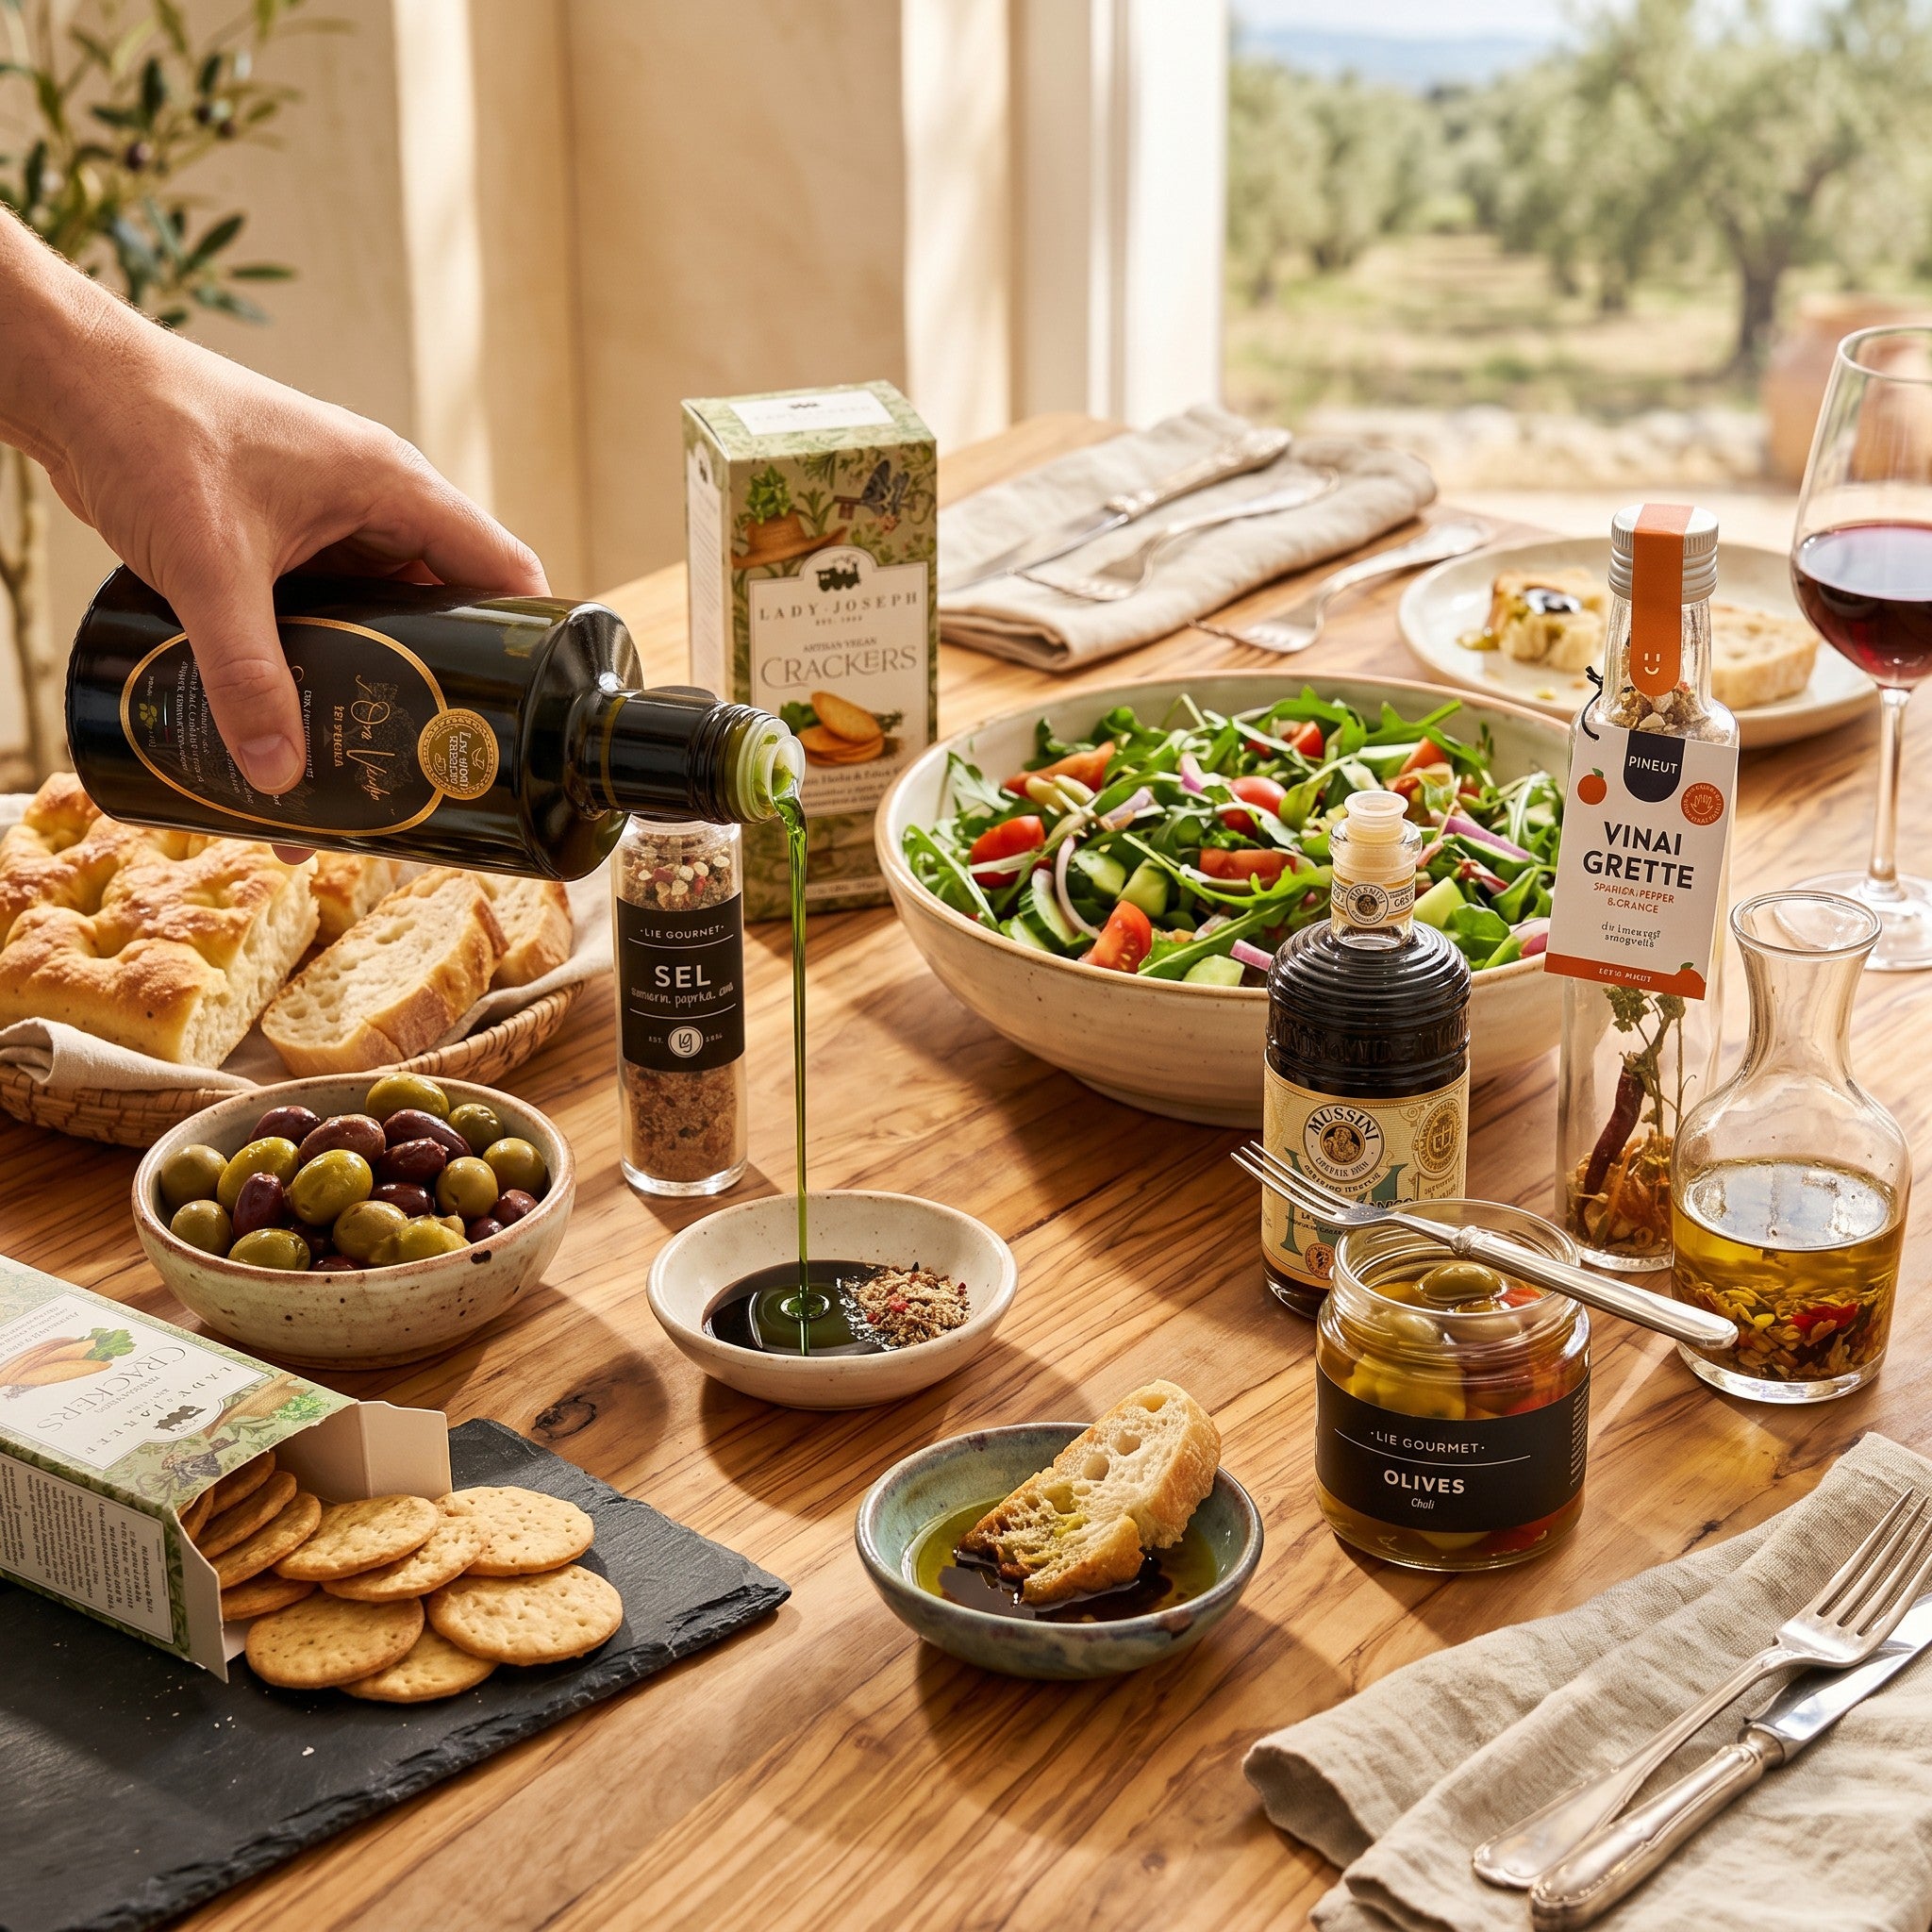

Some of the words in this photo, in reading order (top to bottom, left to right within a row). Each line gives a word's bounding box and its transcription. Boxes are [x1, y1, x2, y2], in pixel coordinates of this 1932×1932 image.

[759, 602, 820, 622] LADY
[832, 591, 918, 615] JOSEPH
[759, 644, 918, 690] CRACKERS
[1628, 756, 1678, 774] PINEUT
[1604, 821, 1682, 856] VINAI
[1583, 850, 1694, 890] GRETTE
[1639, 890, 1674, 904] PEPPER
[644, 927, 662, 939] LIE
[655, 964, 711, 989] SEL
[1307, 1107, 1380, 1141] MUSSINI
[37, 1346, 187, 1433] CRACKERS
[1376, 1430, 1398, 1446] LIE
[1402, 1438, 1479, 1454] GOURMET
[1383, 1469, 1465, 1494] OLIVES
